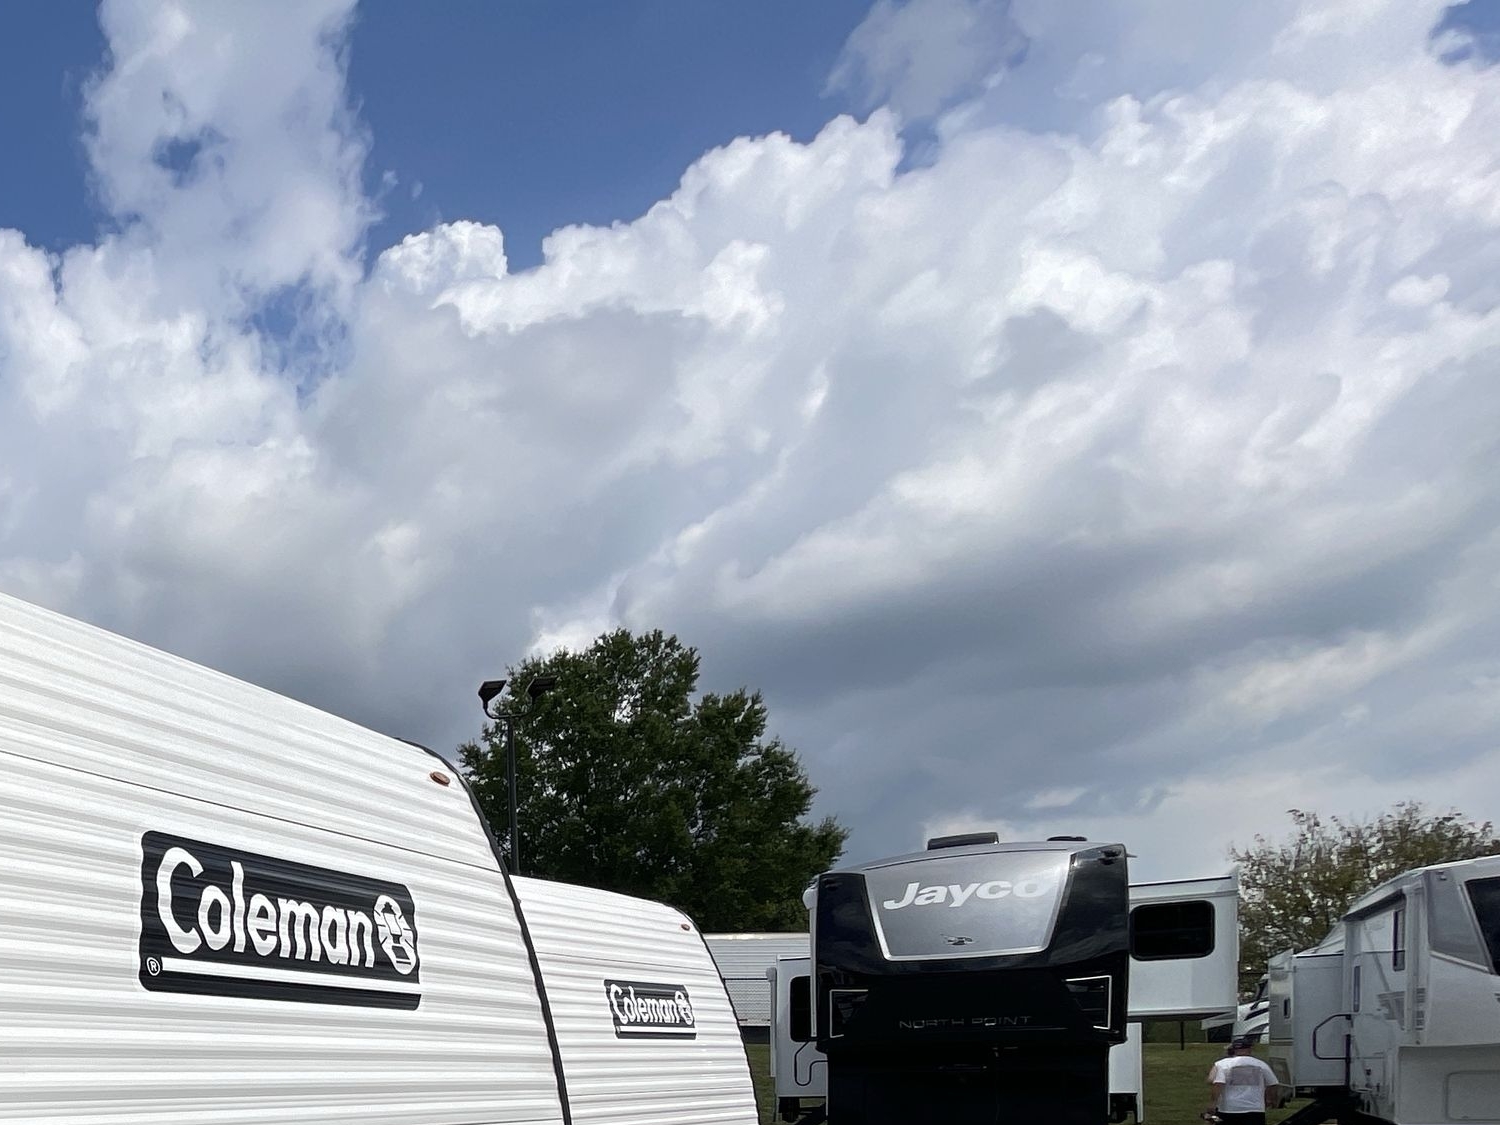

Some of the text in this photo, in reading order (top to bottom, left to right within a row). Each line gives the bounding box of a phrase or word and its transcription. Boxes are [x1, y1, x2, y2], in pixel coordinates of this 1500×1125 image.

[157, 847, 375, 968] Coleman
[883, 880, 1049, 910] Jayco
[610, 984, 680, 1024] Coleman
[899, 1016, 1032, 1029] NORTH POINT
